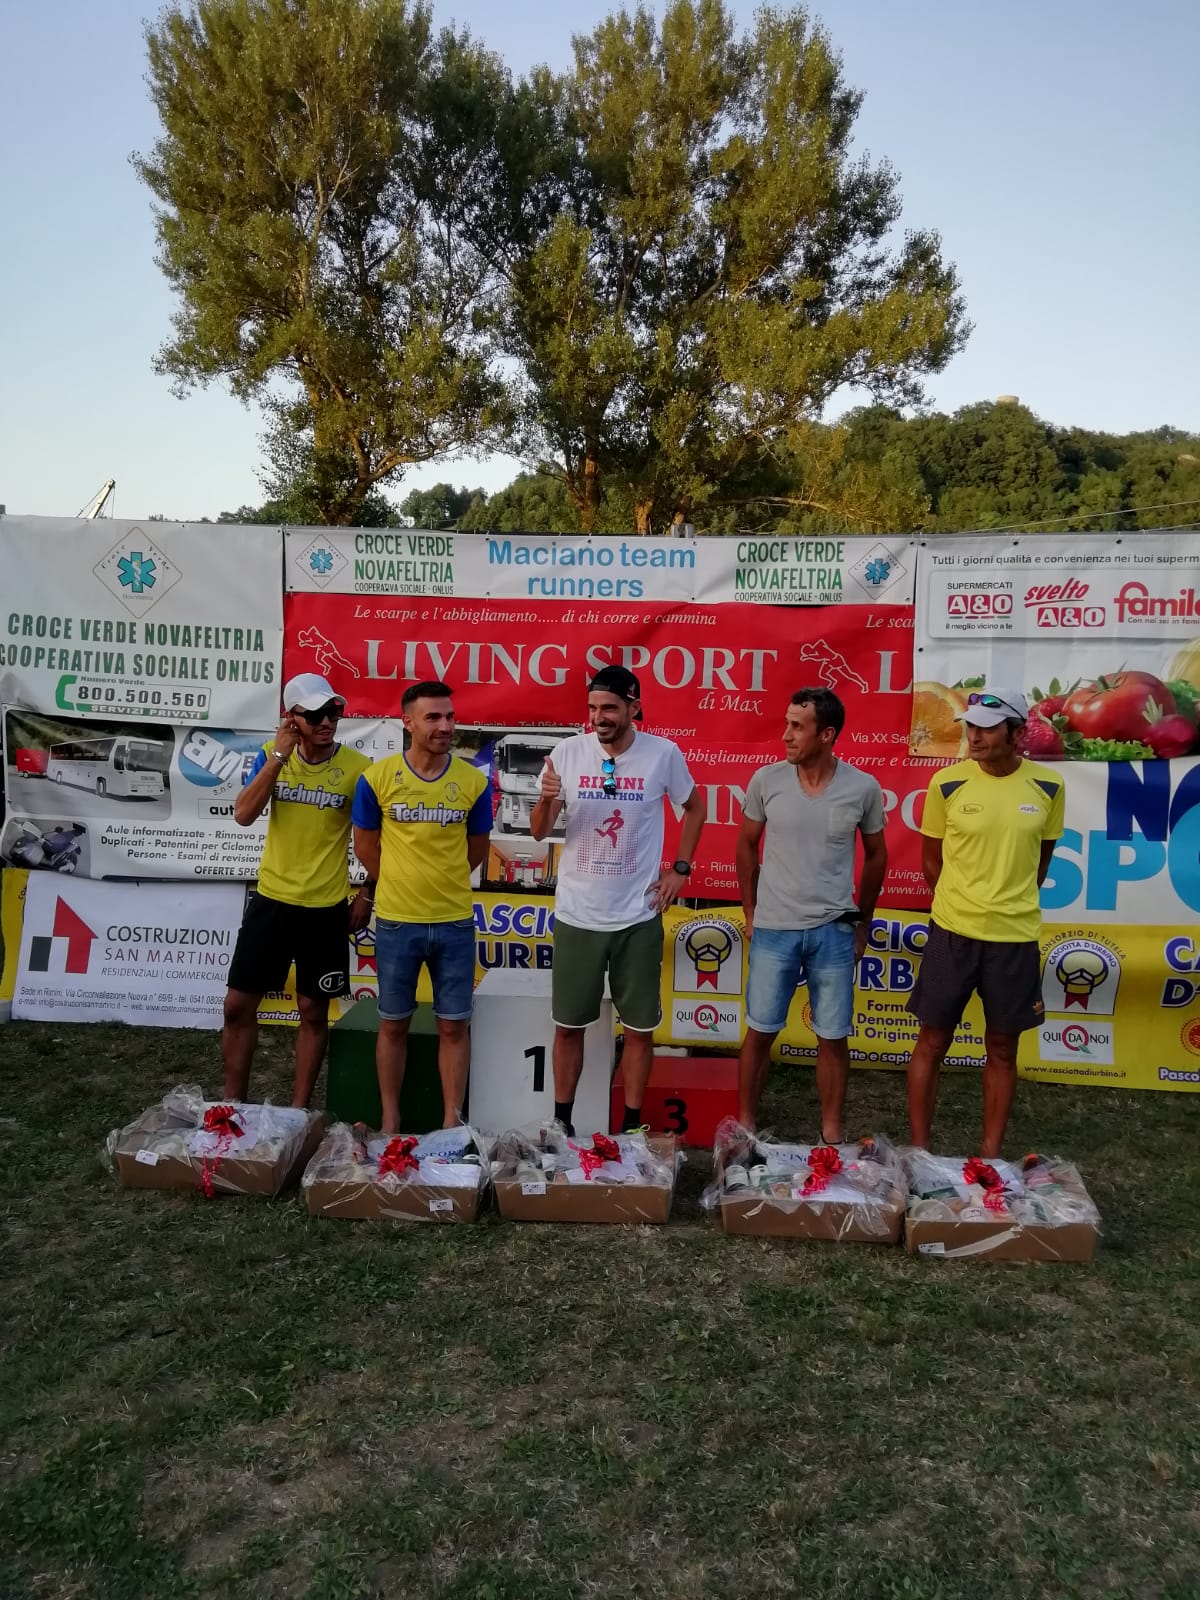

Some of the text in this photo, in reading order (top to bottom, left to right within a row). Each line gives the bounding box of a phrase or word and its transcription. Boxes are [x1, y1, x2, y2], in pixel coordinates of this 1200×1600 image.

[355, 534, 402, 555] CROCE
[407, 536, 455, 557] VERDE
[737, 542, 789, 563] CROCE
[795, 542, 845, 563] VERDE
[488, 540, 696, 569] Maciano team
[932, 555, 955, 565] Tutti
[963, 555, 994, 567] giorni
[1044, 555, 1112, 564] convenienza
[1115, 554, 1131, 563] nei
[1134, 554, 1154, 563] tuoi
[355, 559, 454, 583] NOVAFELTRIA
[735, 568, 843, 590] NOVAFELTRIA
[354, 582, 454, 595] COOPERATIVA SOCIALE ONLUS
[527, 576, 644, 598] runners
[947, 581, 1013, 590] SUPERMERCATI
[1024, 577, 1090, 603] svelto
[734, 591, 842, 602] COOPERATIVA SOCIALE ONLUS
[353, 605, 370, 619] Le
[374, 607, 418, 621] scarpe
[421, 609, 429, 620] e
[561, 610, 575, 623] di
[578, 611, 599, 624] chi
[603, 613, 638, 624] corre
[643, 614, 651, 624] e
[655, 612, 717, 625] cammina
[866, 614, 884, 628] Le
[8, 612, 265, 652] CROCE VERDE NOVAFELTRIA
[951, 622, 975, 631] meglio
[977, 622, 999, 630] vicino
[132, 653, 209, 681] SOCIALE
[216, 658, 275, 684] ONLUS
[363, 639, 571, 687] LIVING
[585, 644, 778, 692] SPORT
[80, 675, 145, 686] Numero Verde
[77, 685, 207, 708] 800.500.560
[698, 693, 763, 716] di Max
[90, 704, 201, 719] SERVIZI PRIVATI
[640, 725, 697, 738] Livingsport
[851, 732, 888, 743] Via XX
[847, 756, 886, 767] corre
[889, 757, 898, 767] e
[275, 780, 346, 810] Technipes
[577, 790, 644, 801] MARATHON
[391, 802, 465, 827] Technipes
[106, 824, 129, 835] Aule
[132, 826, 205, 838] informatizzate
[215, 830, 256, 840] Rinnovo
[101, 836, 145, 847] Duplicati
[154, 839, 199, 850] Patentini
[201, 843, 218, 852] per
[127, 849, 168, 860] Persone
[177, 851, 207, 862] Esami
[210, 852, 219, 862] di
[194, 866, 235, 876] OFFERTE
[106, 925, 231, 946] COSTRUZIONI
[1040, 929, 1084, 956] CONSORZIO
[1100, 935, 1126, 960] TUTELA
[105, 947, 230, 966] SAN MARTINO
[1049, 941, 1117, 967] CASCIOTTA D'URBINO
[101, 967, 228, 982] RESIDENZIALI COMMERCIALI
[20, 986, 36, 996] Sede
[65, 988, 76, 998] Via
[76, 989, 126, 1000] Circonvallazione
[127, 992, 148, 1001] Nuova
[676, 1011, 737, 1023] QUI DA NOI
[864, 1027, 918, 1042] Origine
[1042, 1031, 1110, 1044] QUI DA NOI
[869, 1052, 877, 1061] e
[523, 1045, 546, 1093] 1
[1024, 1065, 1127, 1079] www.casciottadiurbino.it
[662, 1098, 689, 1135] 3
